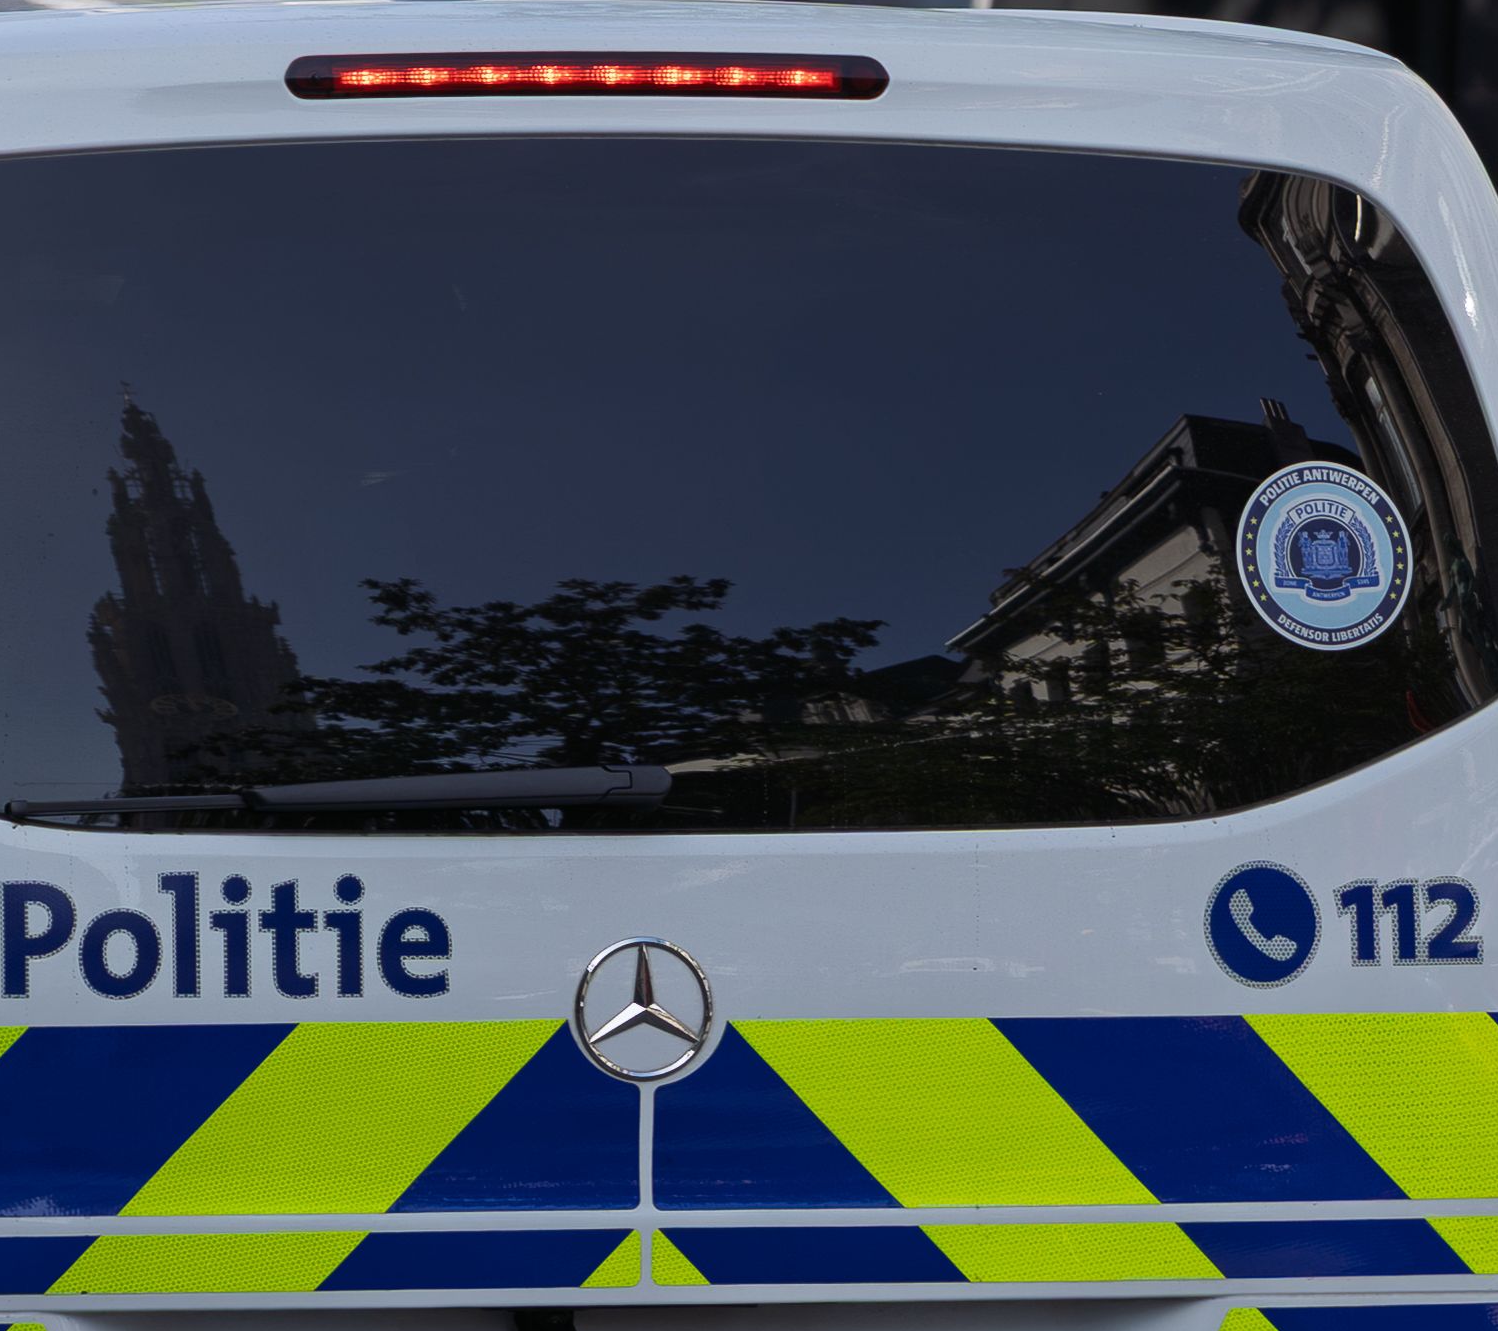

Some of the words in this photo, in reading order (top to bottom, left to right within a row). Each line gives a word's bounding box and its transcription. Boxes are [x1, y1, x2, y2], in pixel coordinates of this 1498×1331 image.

[1259, 472, 1301, 507] POLITIE
[1303, 469, 1380, 505] ANTWERPEN
[1295, 502, 1348, 519] POLITIE
[1277, 614, 1330, 642] DEFENSOR
[1331, 613, 1384, 642] LIBERTATIS
[0, 871, 454, 1001] Politie
[1333, 876, 1485, 967] 112
